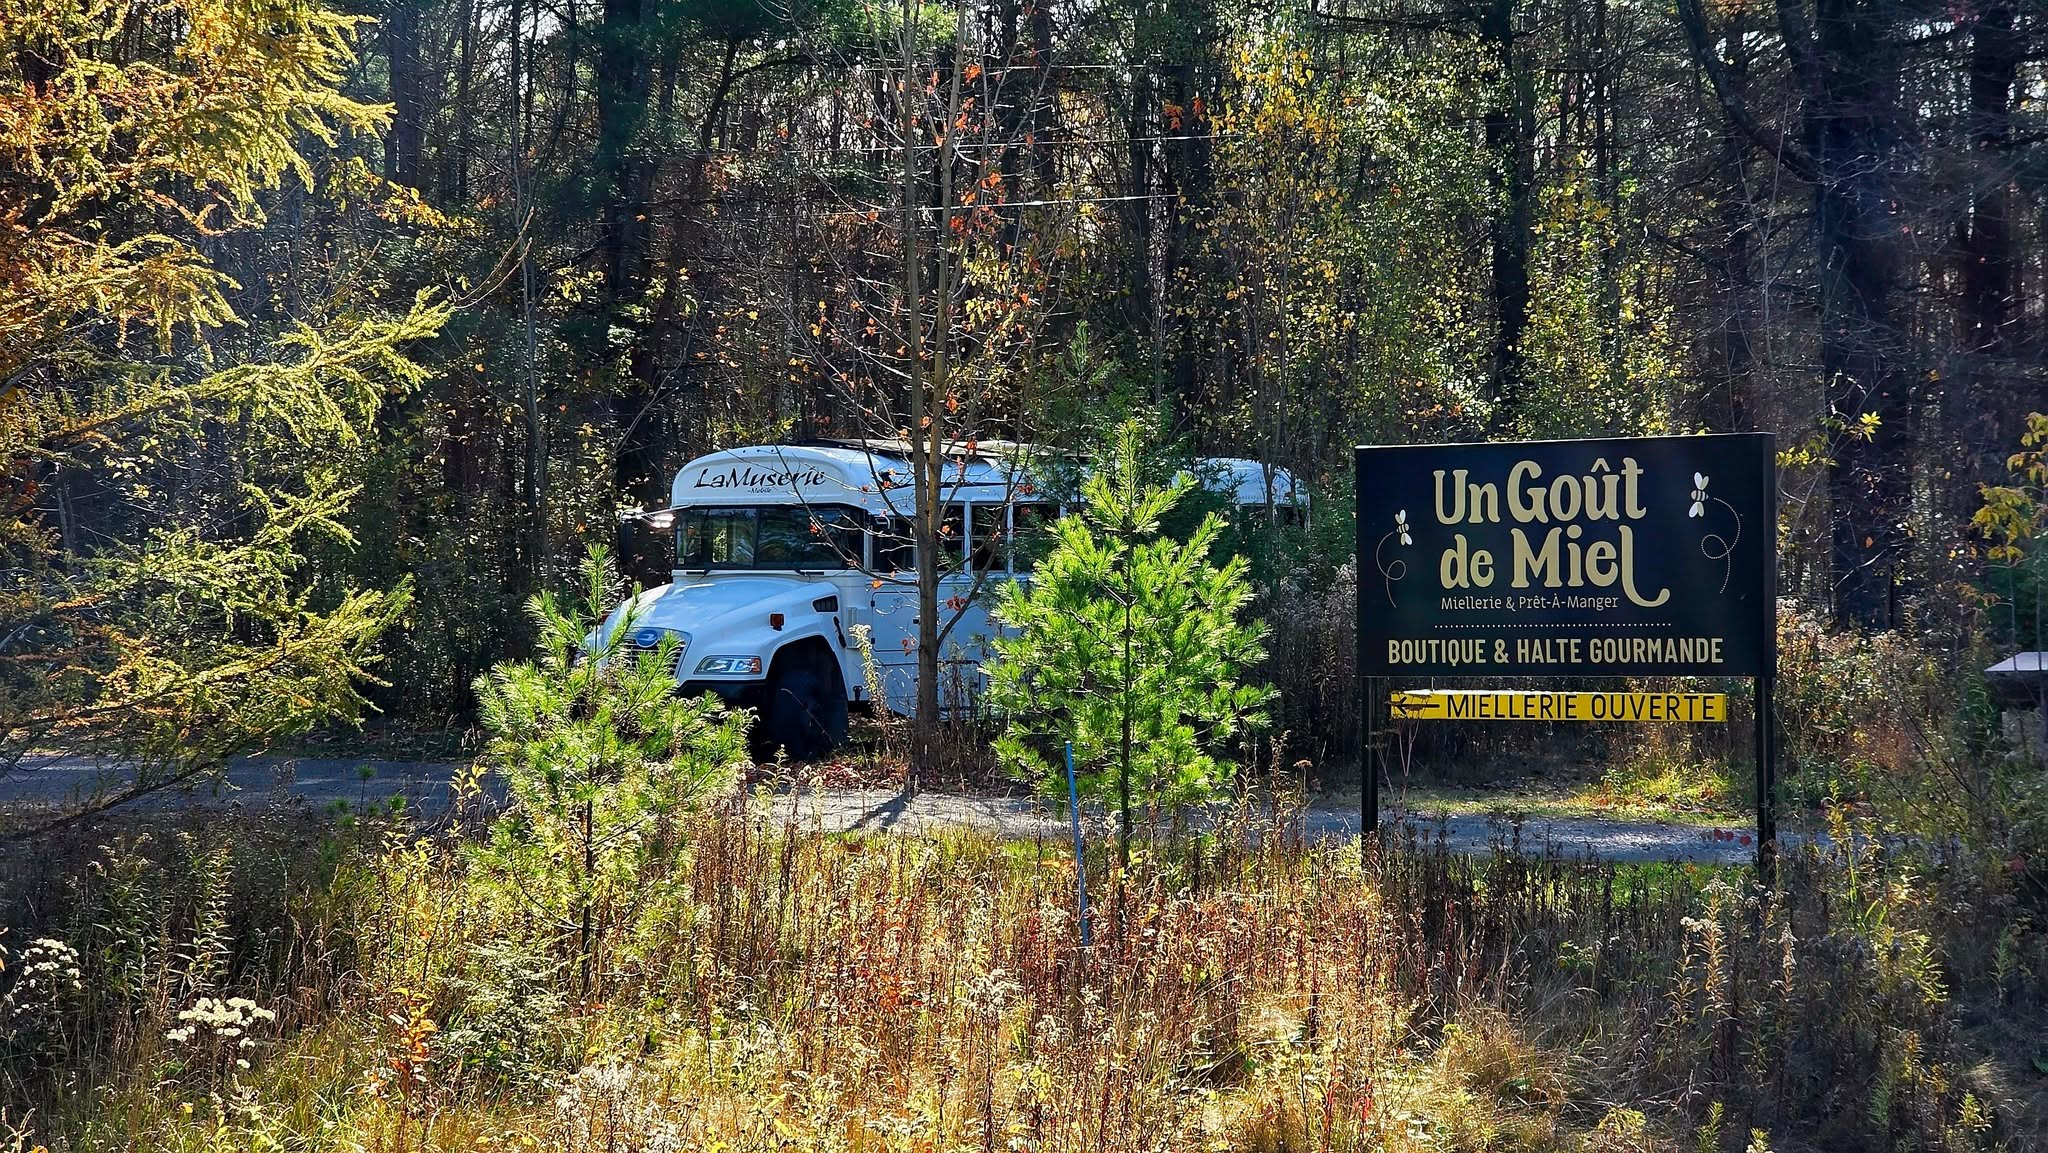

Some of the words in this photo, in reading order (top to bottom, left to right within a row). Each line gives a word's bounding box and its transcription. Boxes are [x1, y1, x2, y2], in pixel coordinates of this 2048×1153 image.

[1433, 469, 1500, 524] Un
[1507, 457, 1647, 523] Goût
[1440, 534, 1495, 589] de
[1511, 525, 1671, 607] Miel
[1441, 595, 1502, 610] Miellerie
[1505, 596, 1516, 611] &
[1519, 593, 1619, 611] Prêt-À-Manger
[1388, 638, 1487, 666] BOUTIQUE
[1493, 639, 1510, 663] &
[1517, 638, 1582, 663] HALTE
[1589, 637, 1724, 663] GOURMANDE
[1447, 694, 1578, 719] MIELLERIE
[1591, 694, 1716, 720] OUVERTE
